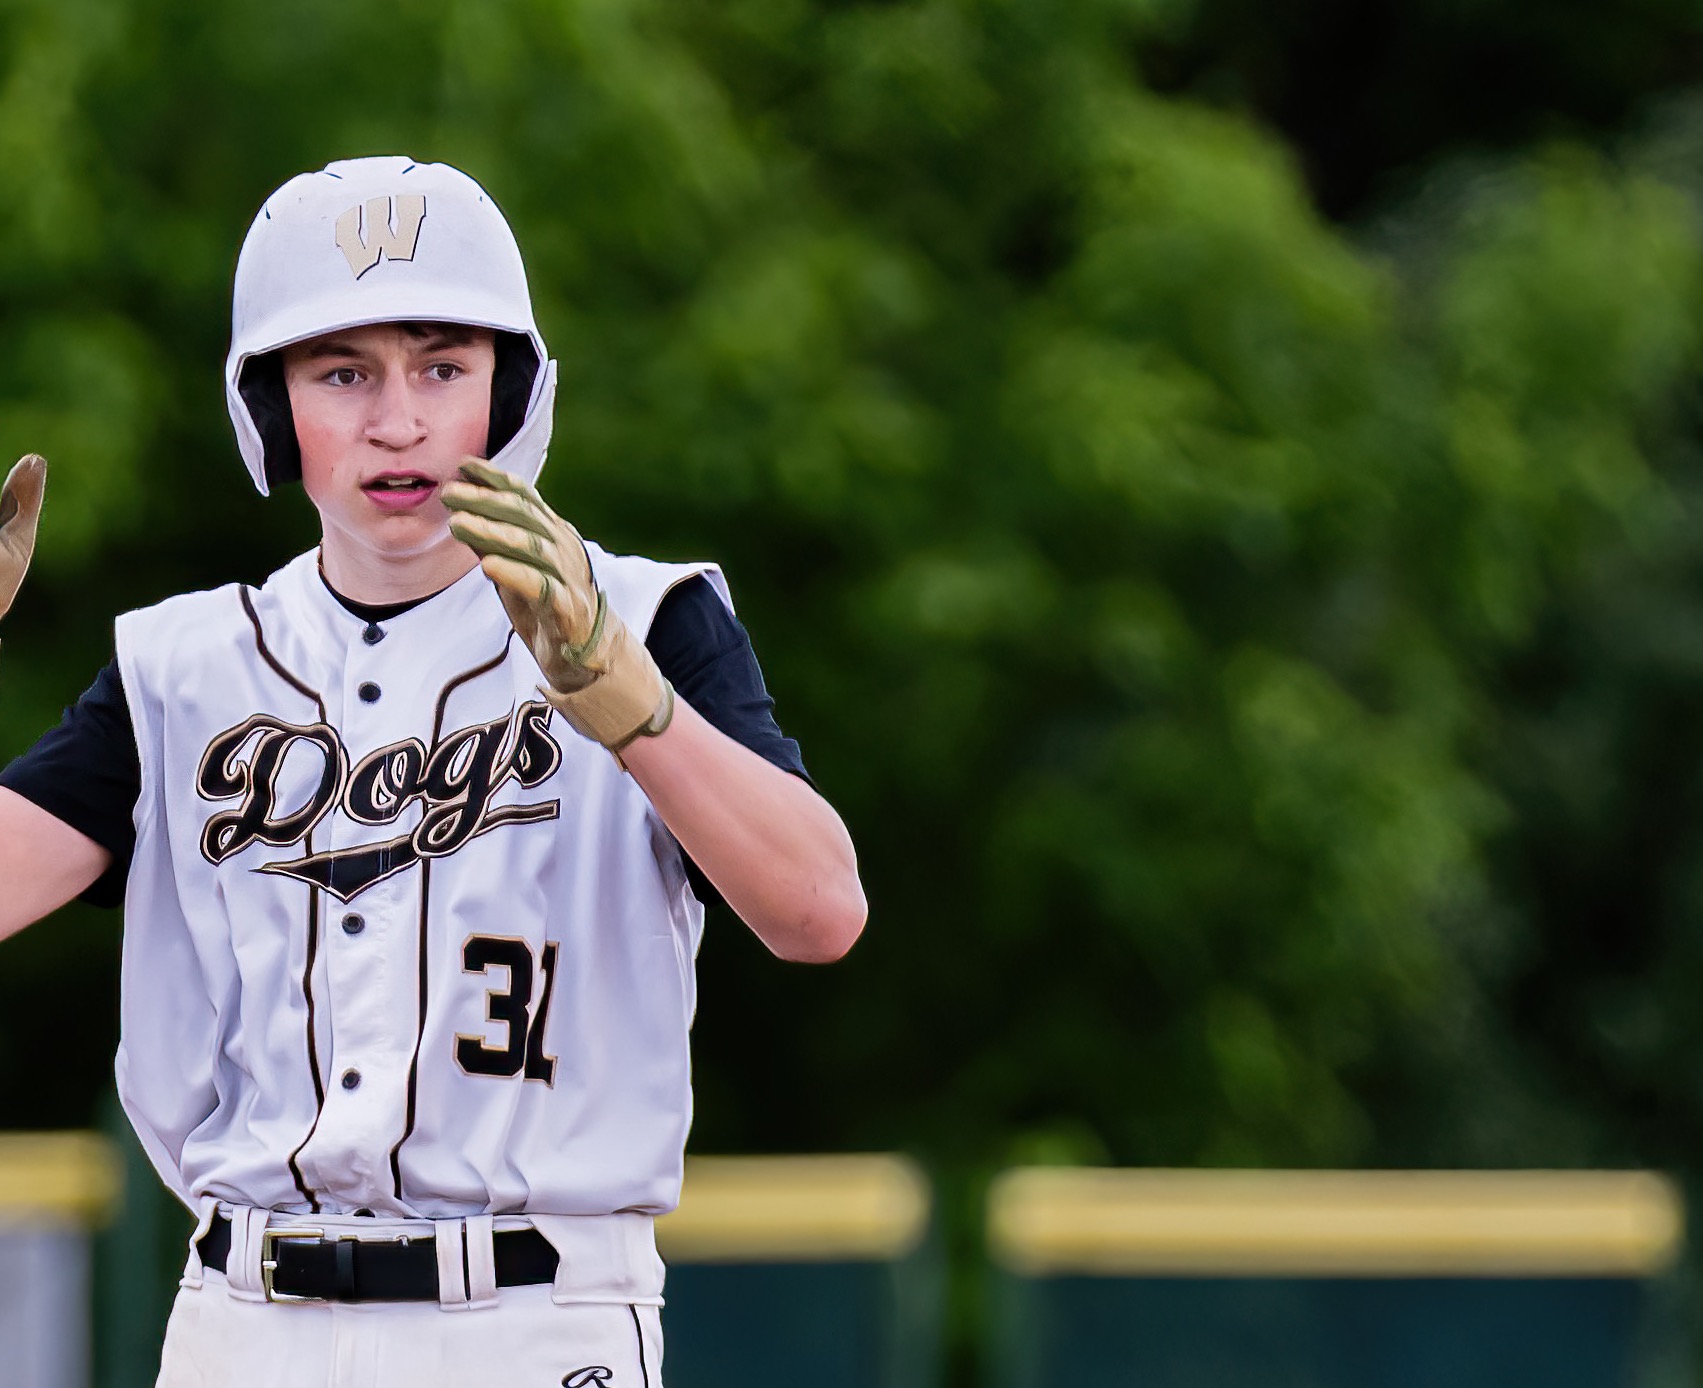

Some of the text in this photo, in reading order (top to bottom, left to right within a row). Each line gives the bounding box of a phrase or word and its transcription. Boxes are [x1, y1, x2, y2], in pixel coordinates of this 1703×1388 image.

[335, 194, 427, 281] W
[196, 700, 563, 866] Dogs
[453, 932, 560, 1090] 31
